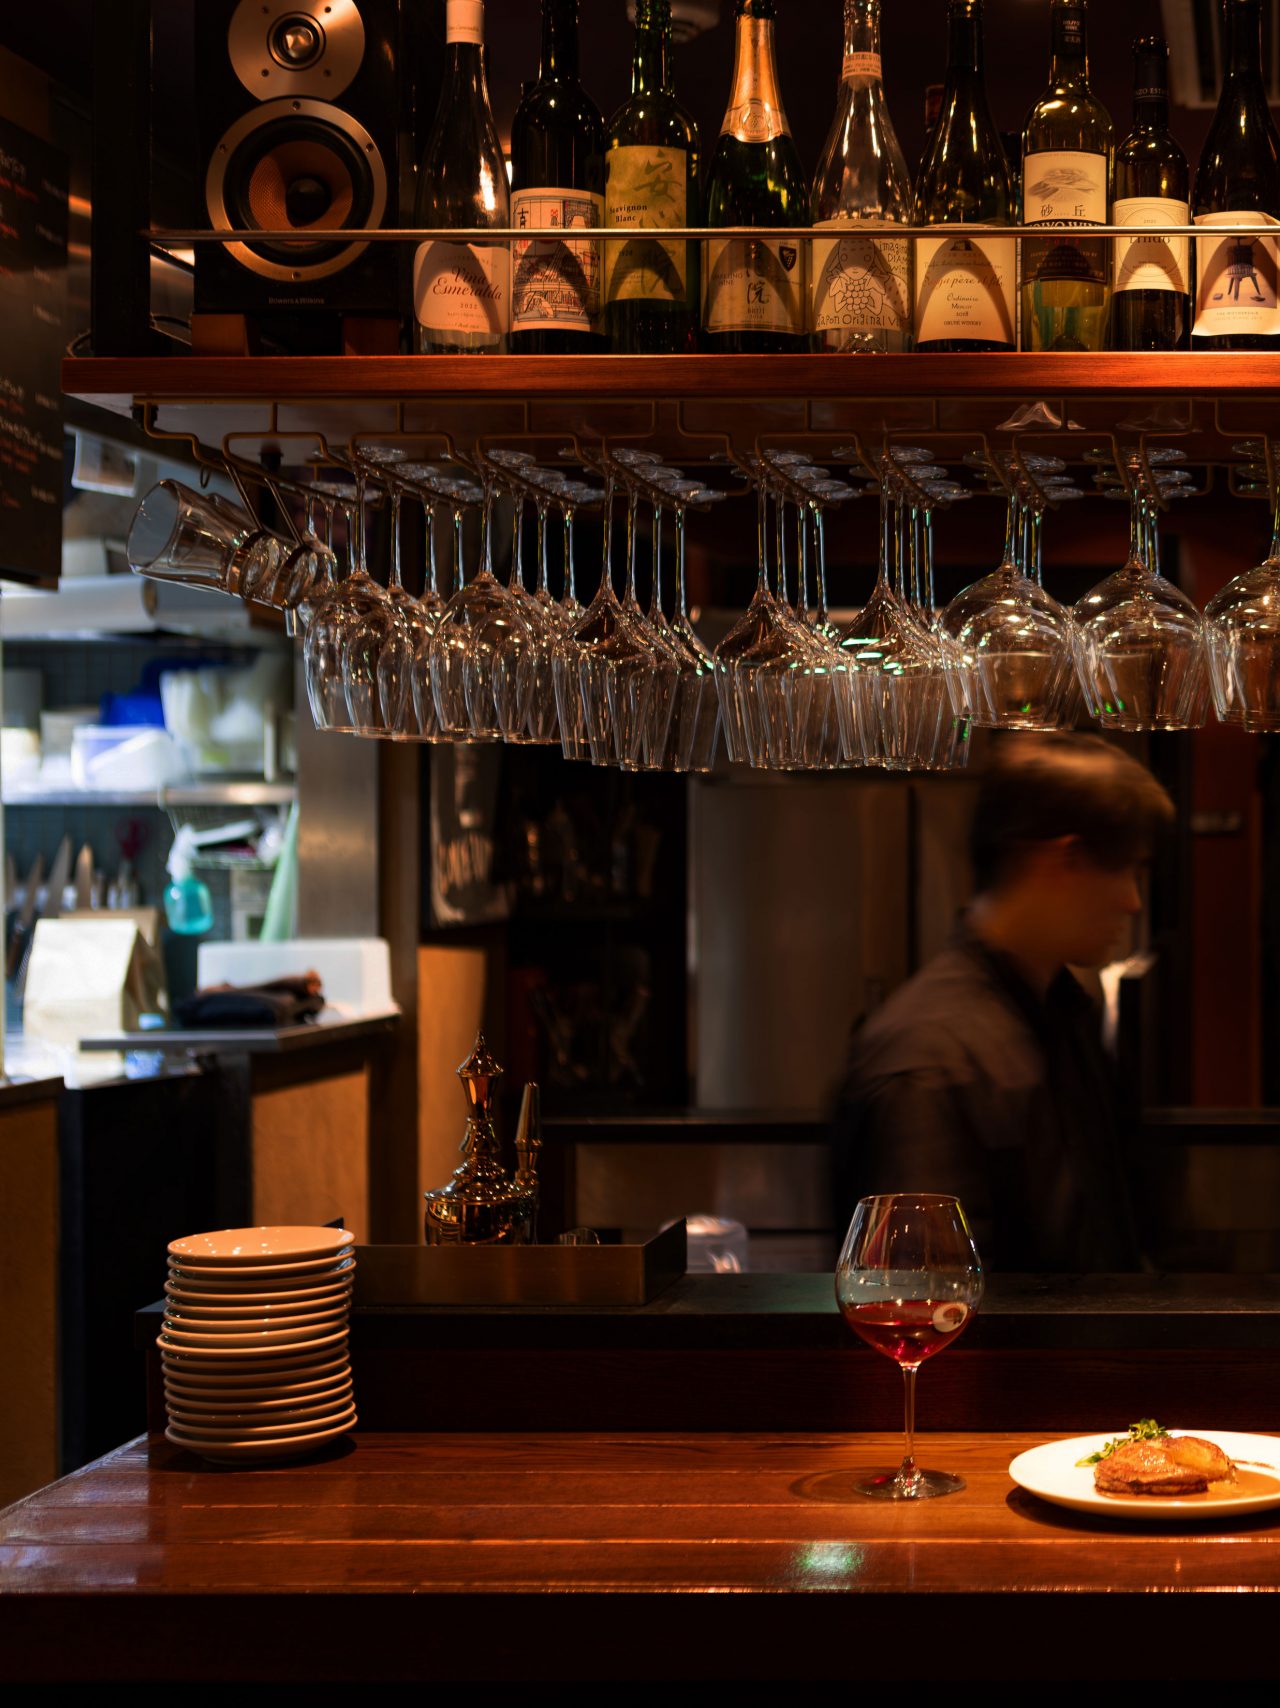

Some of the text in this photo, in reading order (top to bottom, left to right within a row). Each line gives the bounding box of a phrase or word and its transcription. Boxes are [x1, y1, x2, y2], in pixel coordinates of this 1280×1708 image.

[608, 203, 648, 215] Sauvignon
[615, 215, 636, 223] Blanc
[433, 277, 502, 300] Esmeralda
[842, 314, 886, 327] Original
